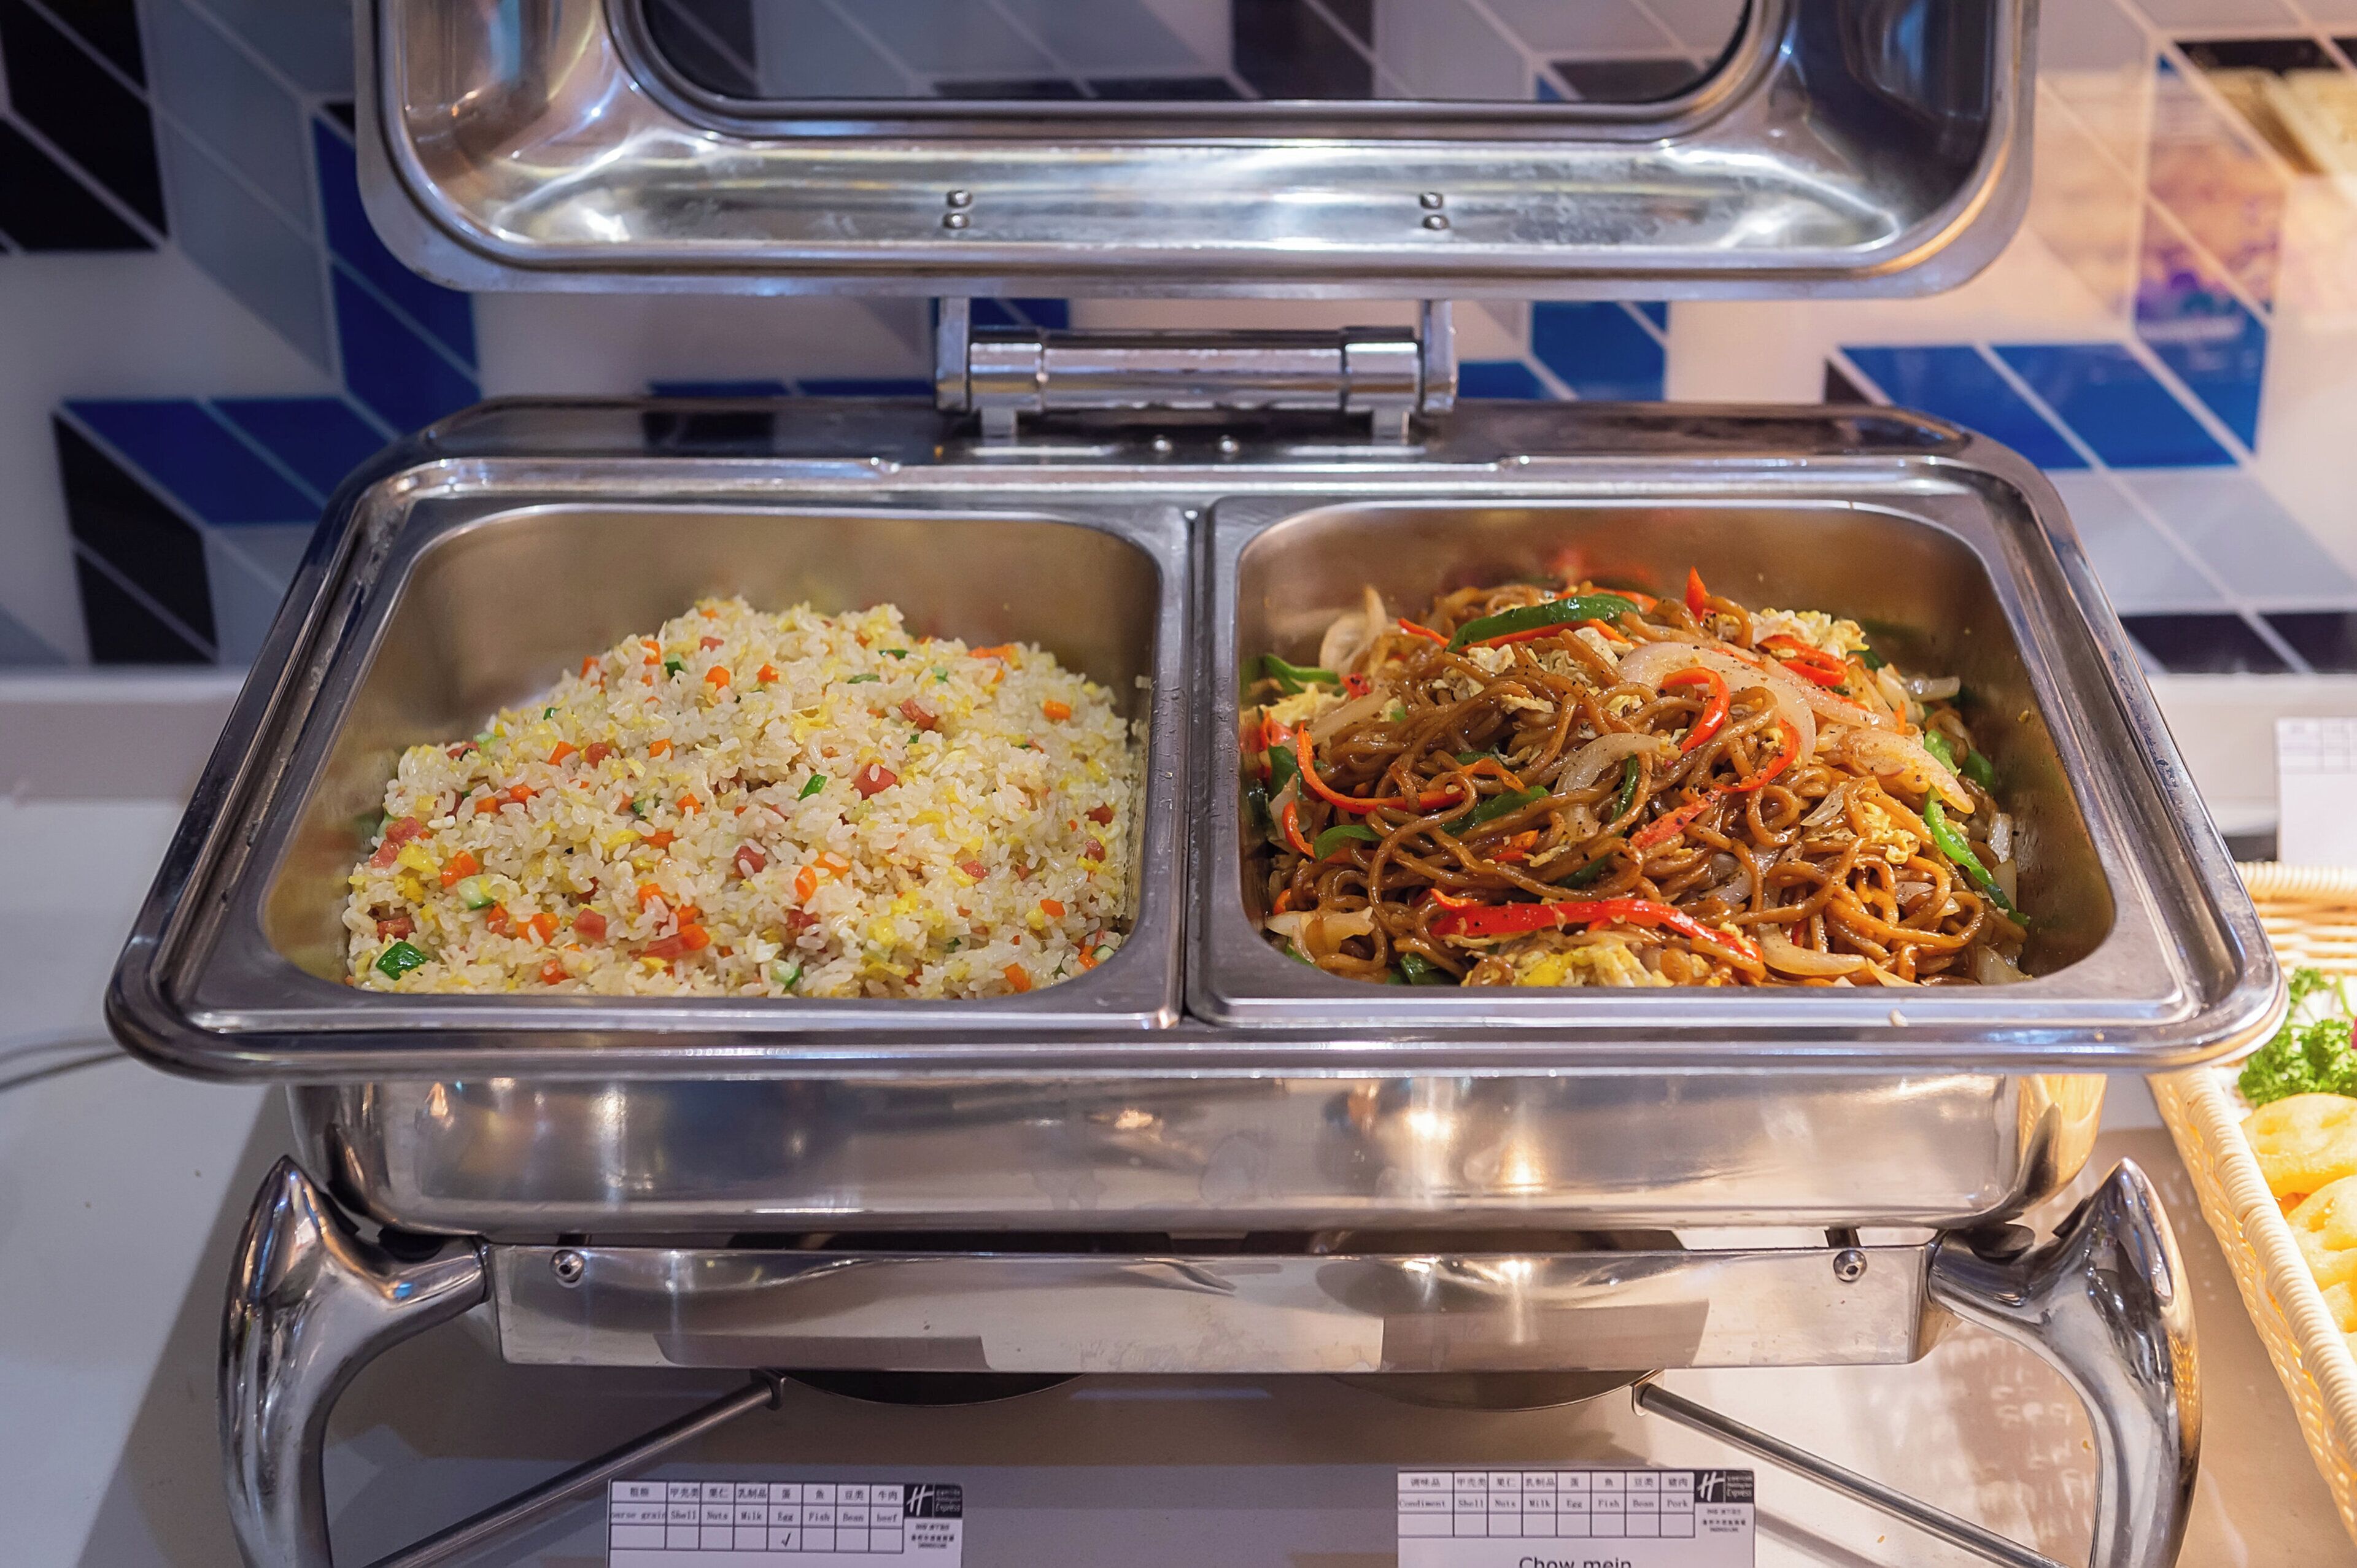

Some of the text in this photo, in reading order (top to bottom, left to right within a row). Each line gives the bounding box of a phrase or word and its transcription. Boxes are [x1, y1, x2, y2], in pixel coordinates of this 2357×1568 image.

[1497, 1478, 1515, 1487] 果仁
[1571, 1478, 1578, 1487] 蛋
[1635, 1478, 1653, 1487] 豆类
[1668, 1478, 1687, 1486] 猪肉
[710, 1488, 728, 1498] 果仁
[738, 1488, 766, 1499] 乳制品
[783, 1489, 790, 1499] 蛋
[845, 1490, 864, 1500] 豆类
[878, 1491, 897, 1500] 牛肉
[671, 1510, 696, 1520] Shell
[707, 1512, 728, 1520] Nuts
[741, 1512, 762, 1521] Milk
[778, 1512, 794, 1522] Egg
[809, 1512, 830, 1522] Fish
[843, 1512, 864, 1522] Bean
[877, 1513, 897, 1522] beef
[1519, 1557, 1631, 1568] Chow mein
